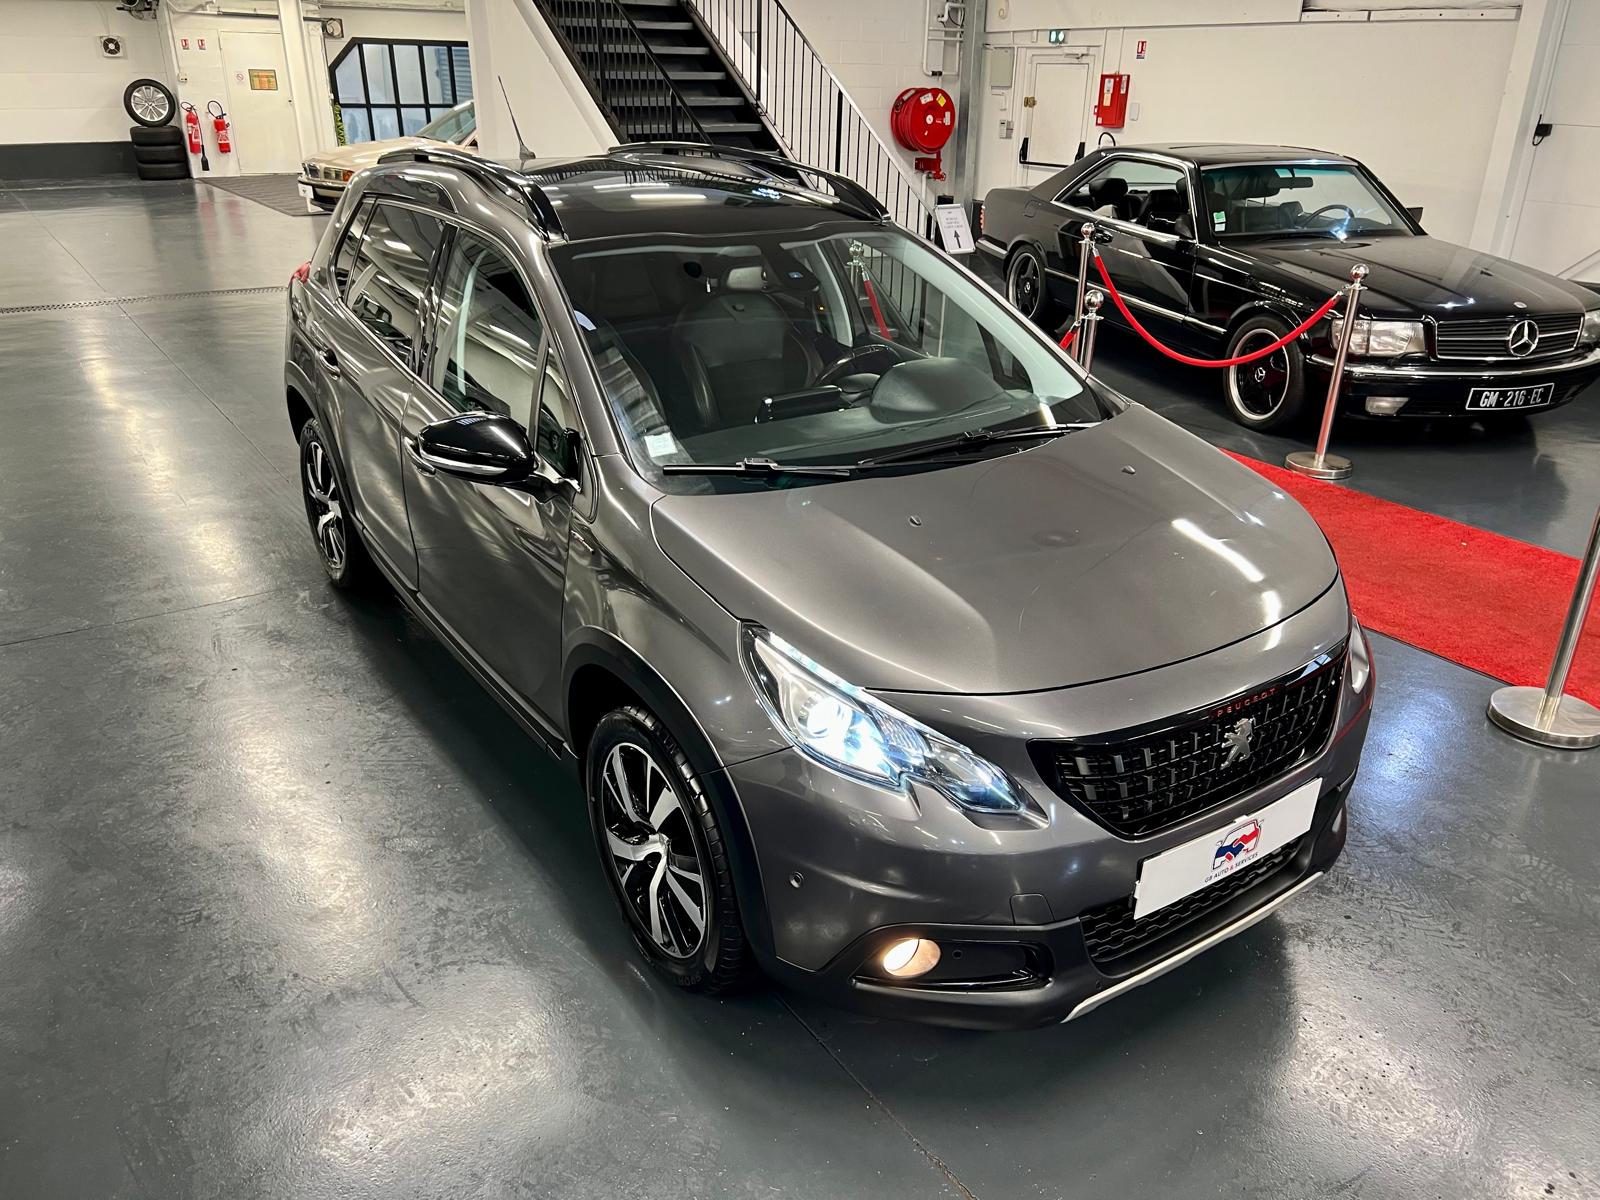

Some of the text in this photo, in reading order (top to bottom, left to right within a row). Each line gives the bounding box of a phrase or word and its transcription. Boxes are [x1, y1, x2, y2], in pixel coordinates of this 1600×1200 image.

[1217, 688, 1276, 717] PEUGEOT
[1213, 867, 1229, 879] AUTO
[1235, 852, 1258, 867] SERVICES
